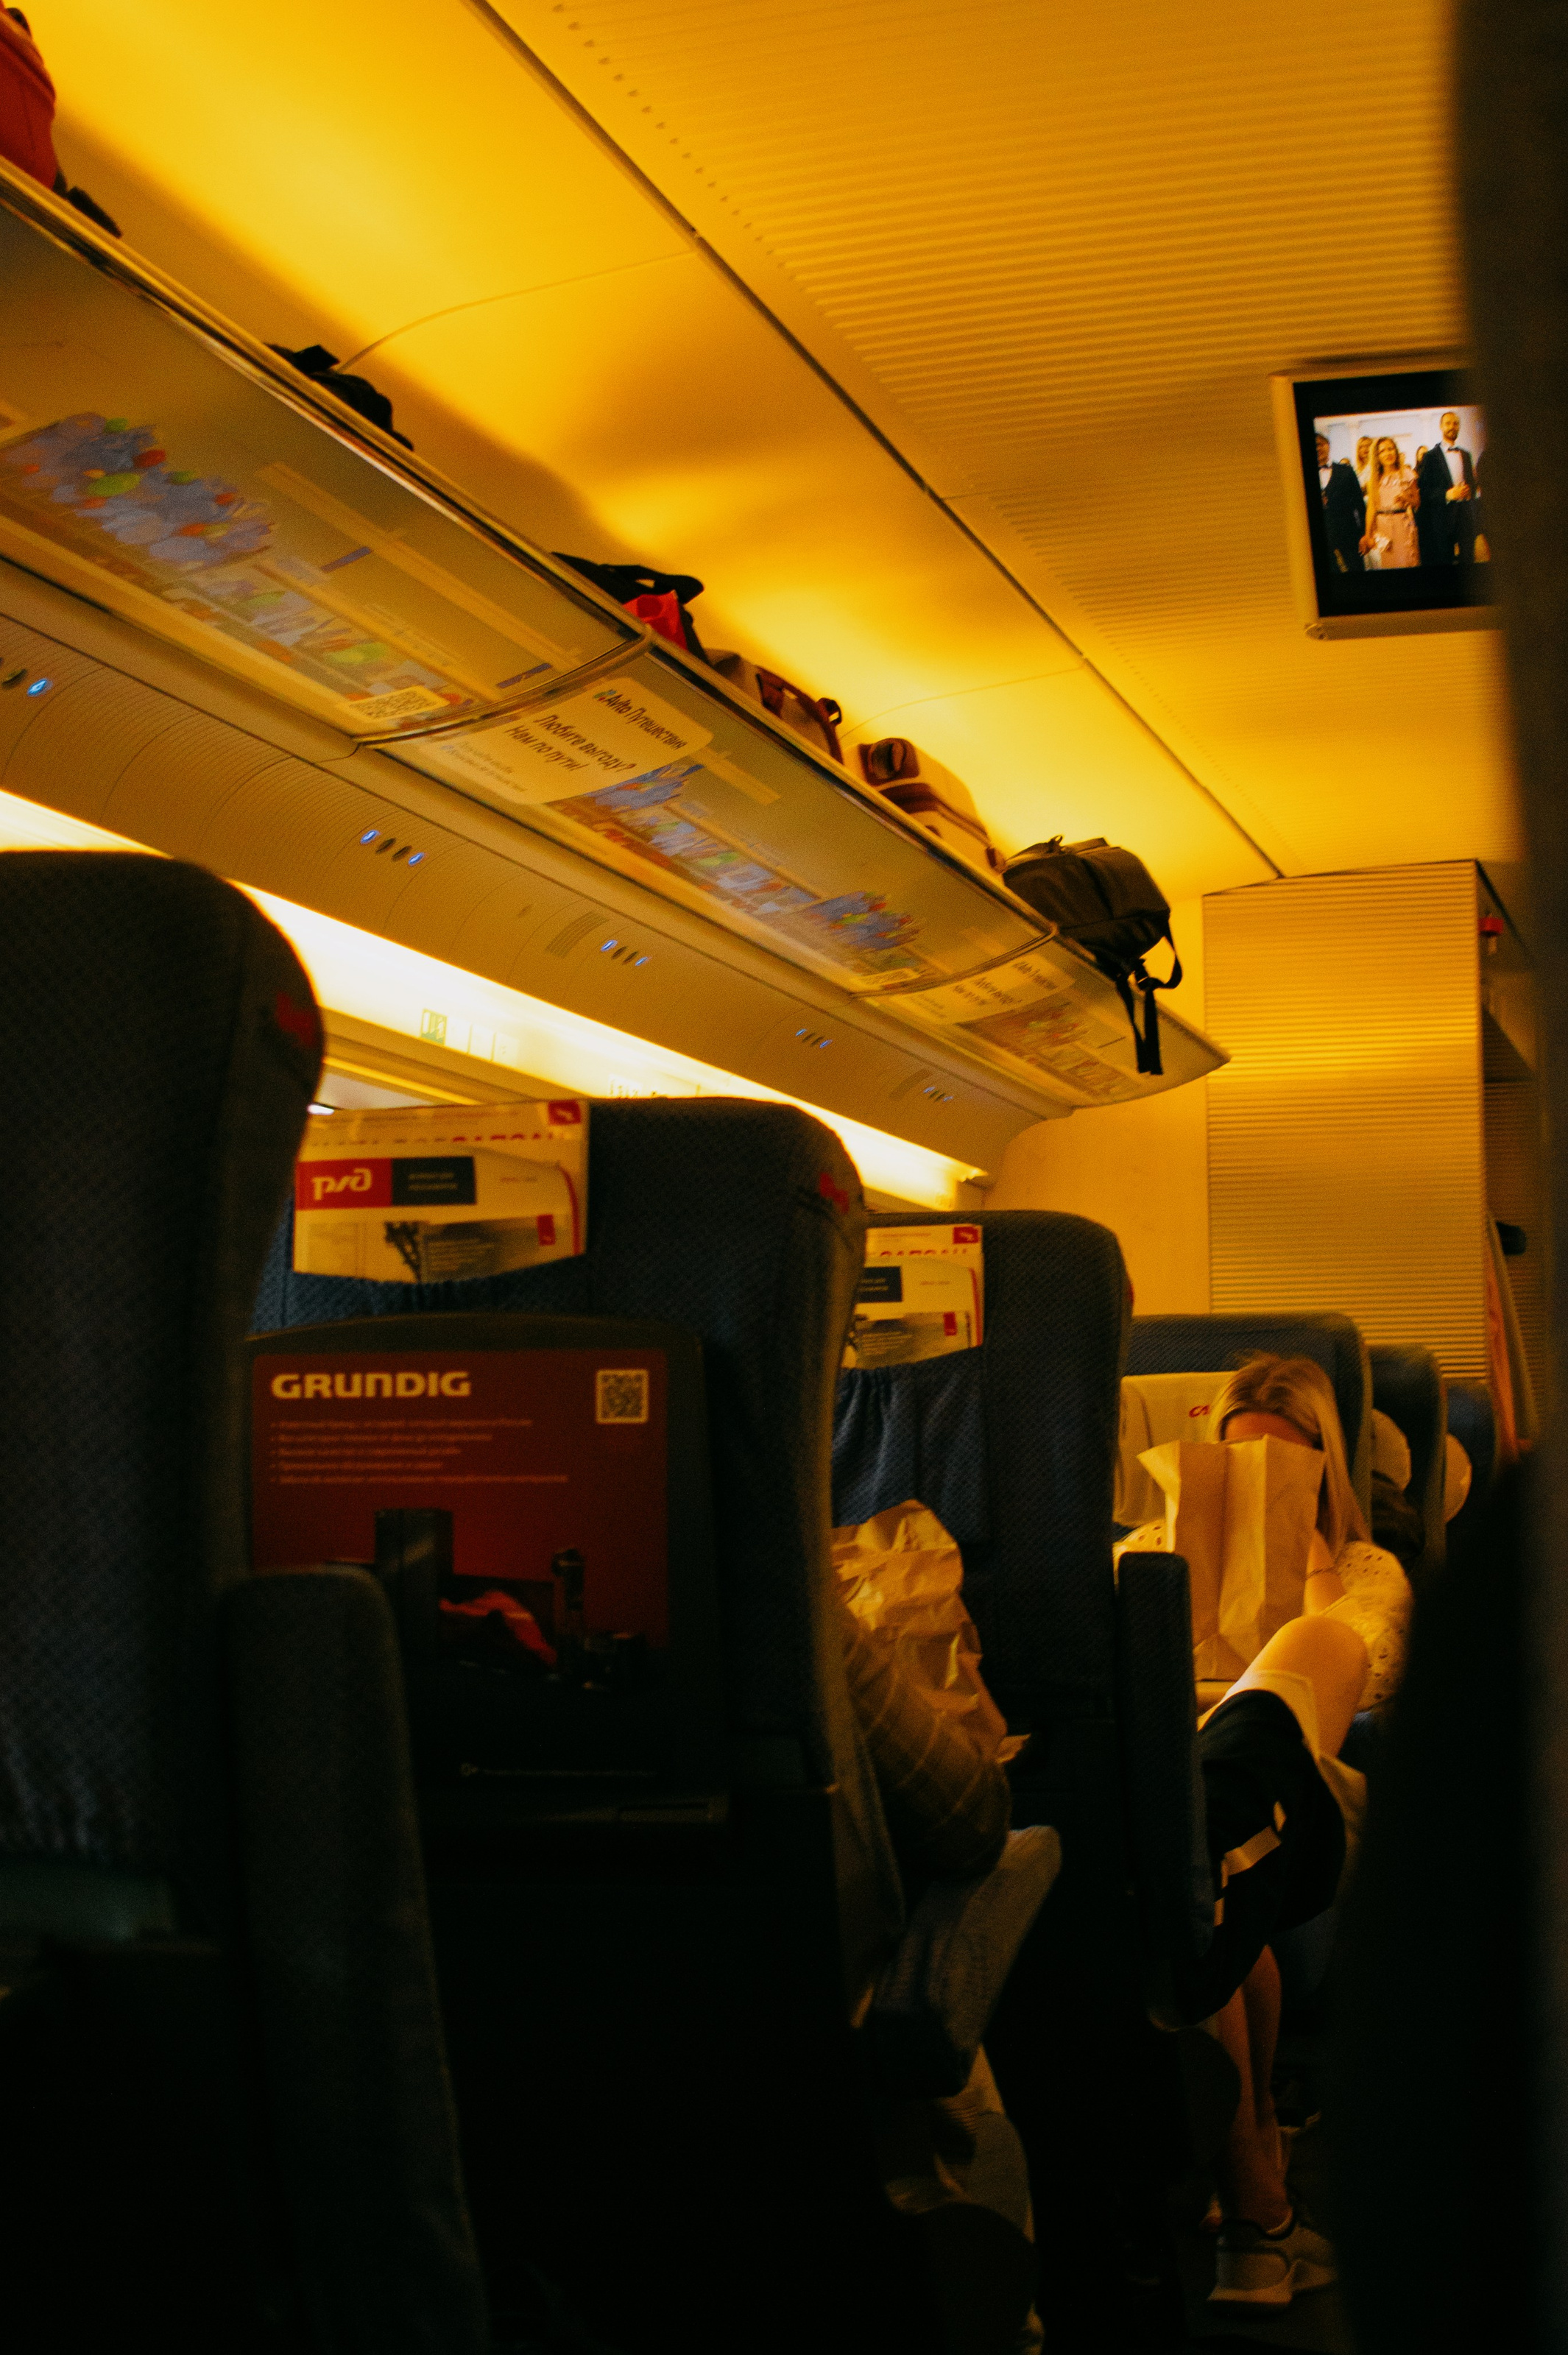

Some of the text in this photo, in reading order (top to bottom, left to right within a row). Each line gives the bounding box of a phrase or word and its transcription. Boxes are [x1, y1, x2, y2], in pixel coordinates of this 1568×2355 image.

[505, 724, 537, 745] Нам
[531, 741, 552, 755] по
[533, 714, 637, 772] Любите выгоду?
[271, 1371, 472, 1399] GRUNDIG
